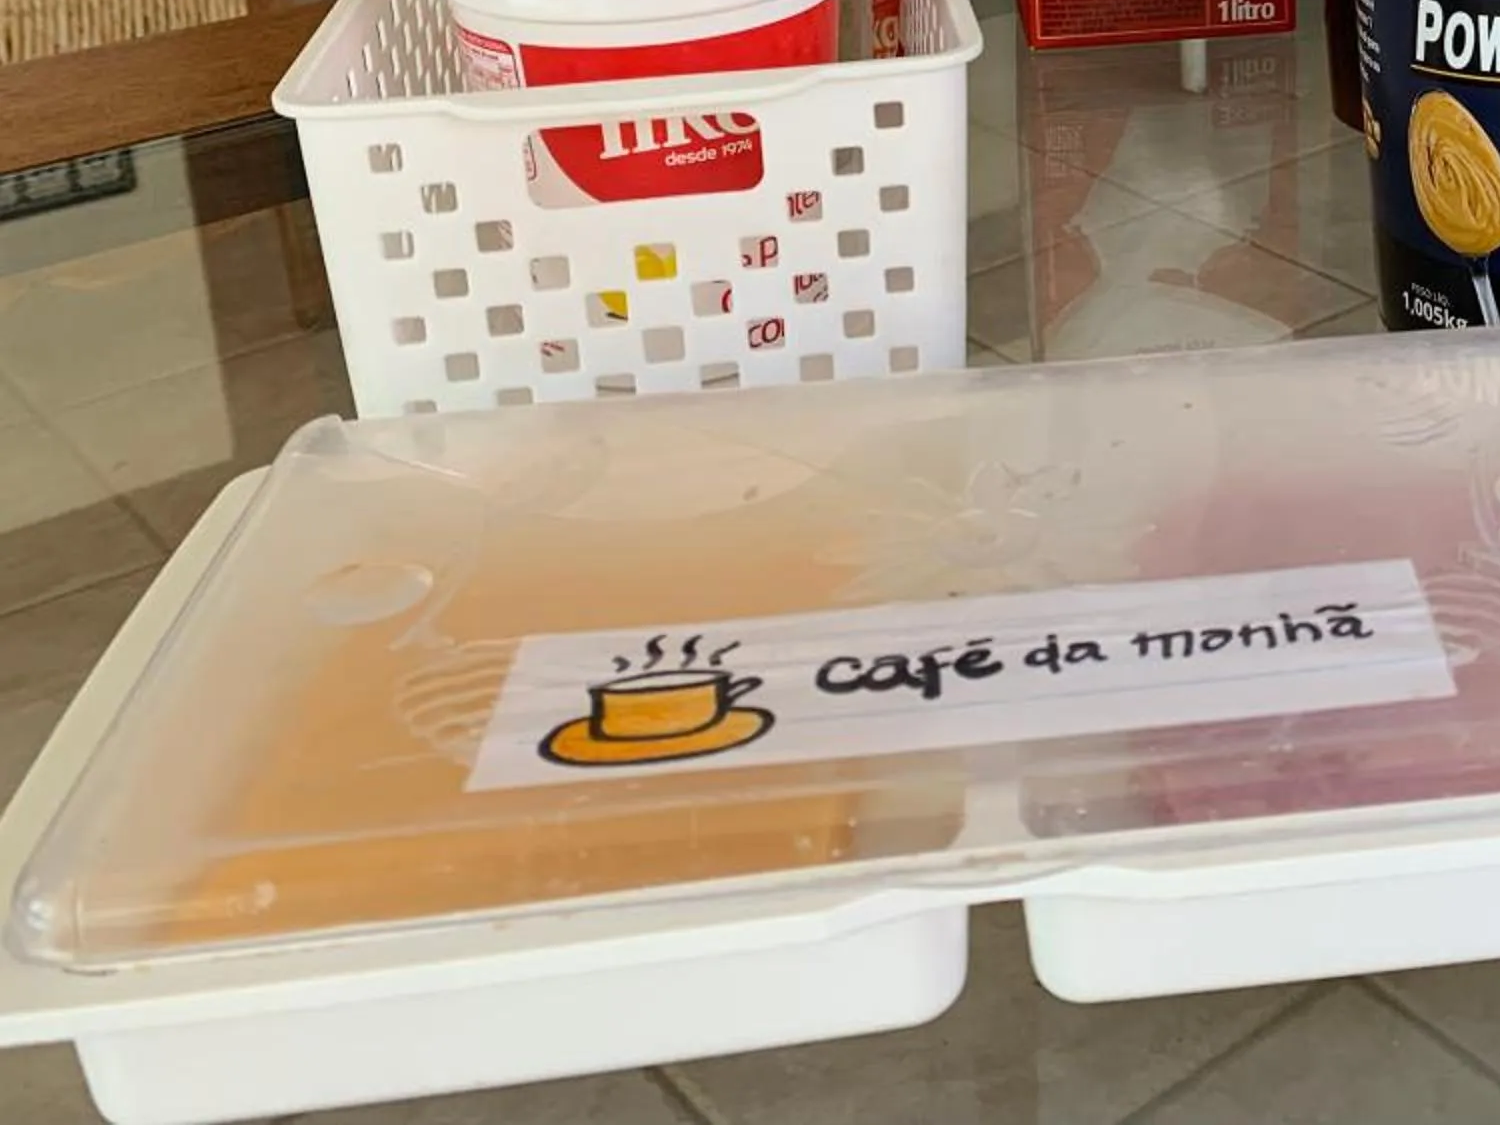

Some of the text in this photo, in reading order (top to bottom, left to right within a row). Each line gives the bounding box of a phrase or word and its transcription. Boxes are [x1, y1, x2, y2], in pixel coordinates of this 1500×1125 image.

[665, 145, 718, 167] desde
[815, 603, 1374, 699] café da manhã
